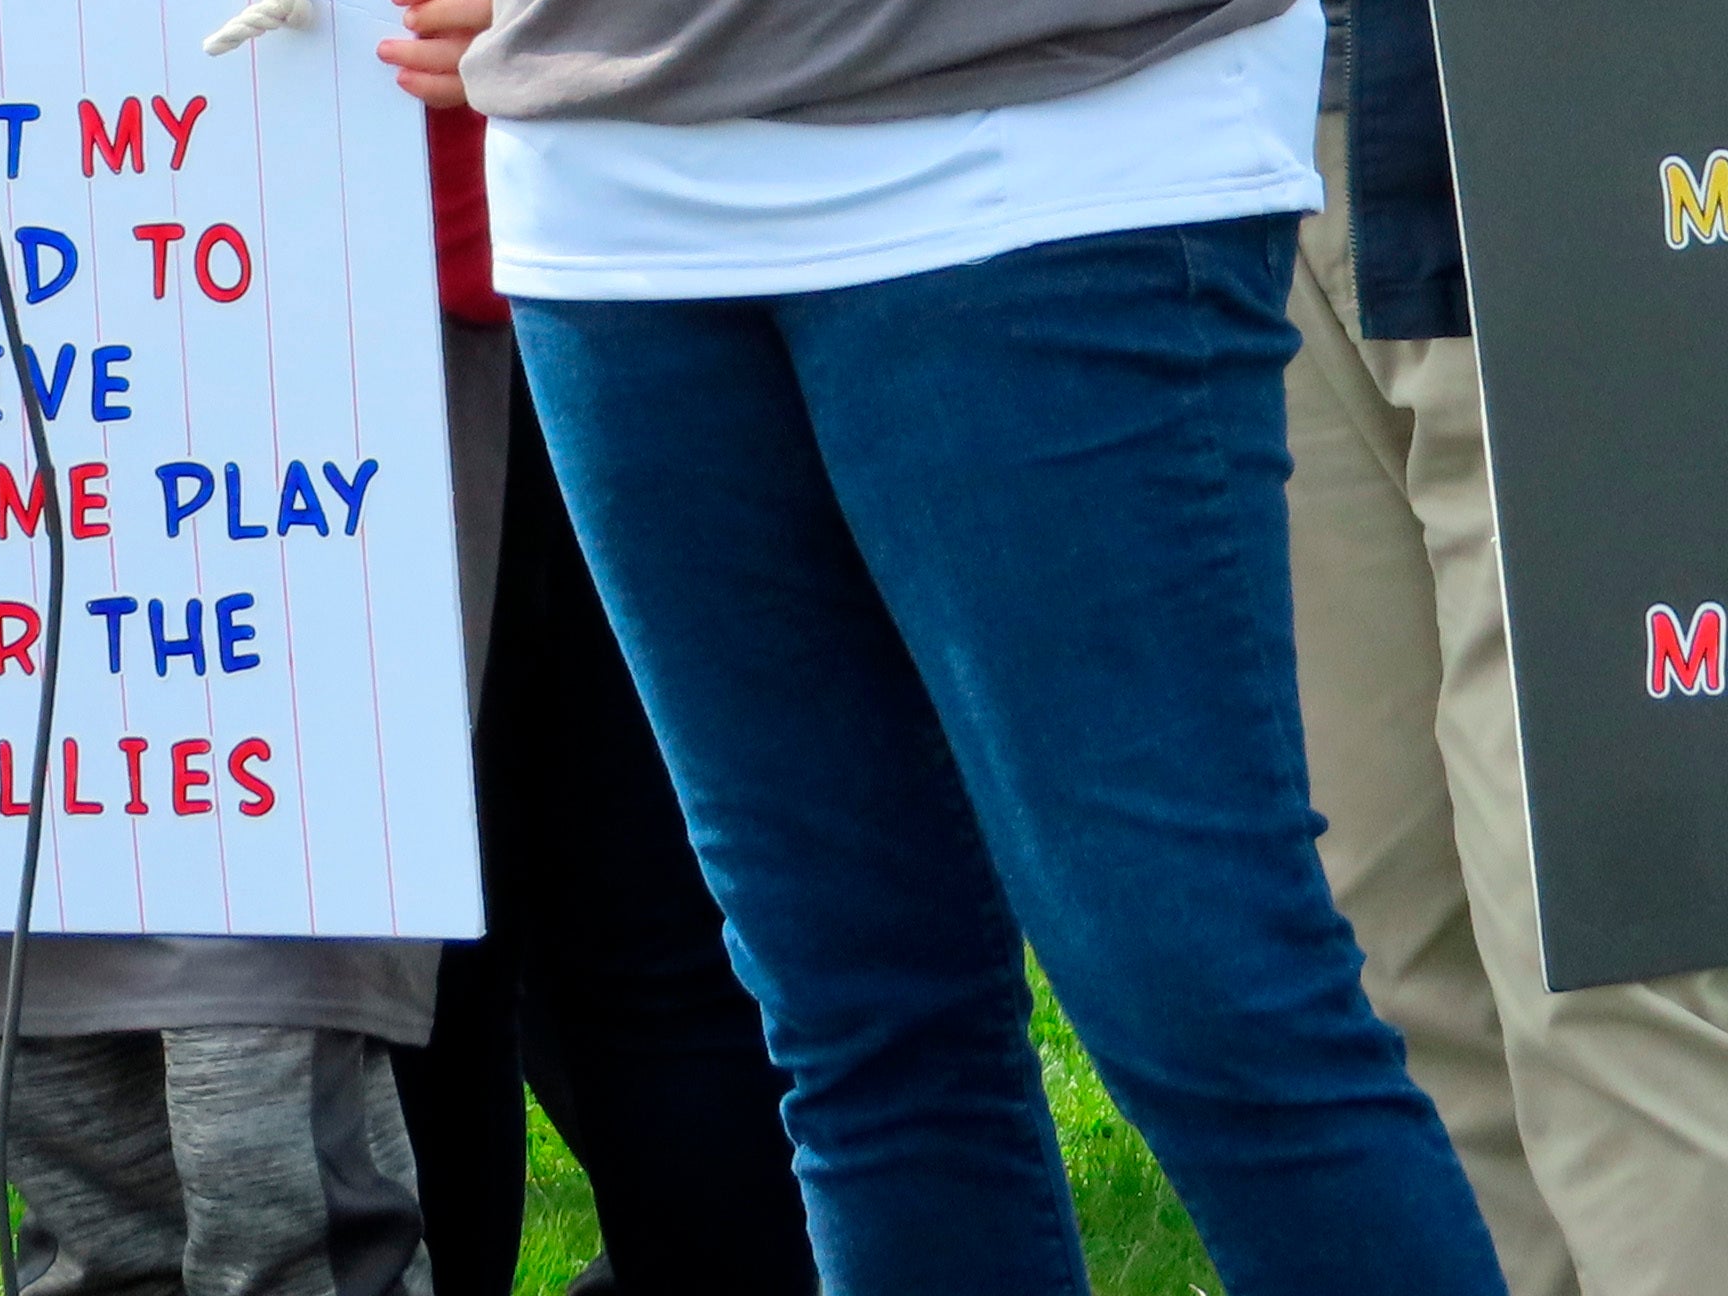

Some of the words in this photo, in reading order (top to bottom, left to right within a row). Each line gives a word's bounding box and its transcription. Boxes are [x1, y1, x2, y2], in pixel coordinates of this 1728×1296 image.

[79, 94, 208, 177] MY
[133, 221, 253, 303] TO
[155, 459, 379, 539] PLAY
[86, 592, 261, 677] THE
